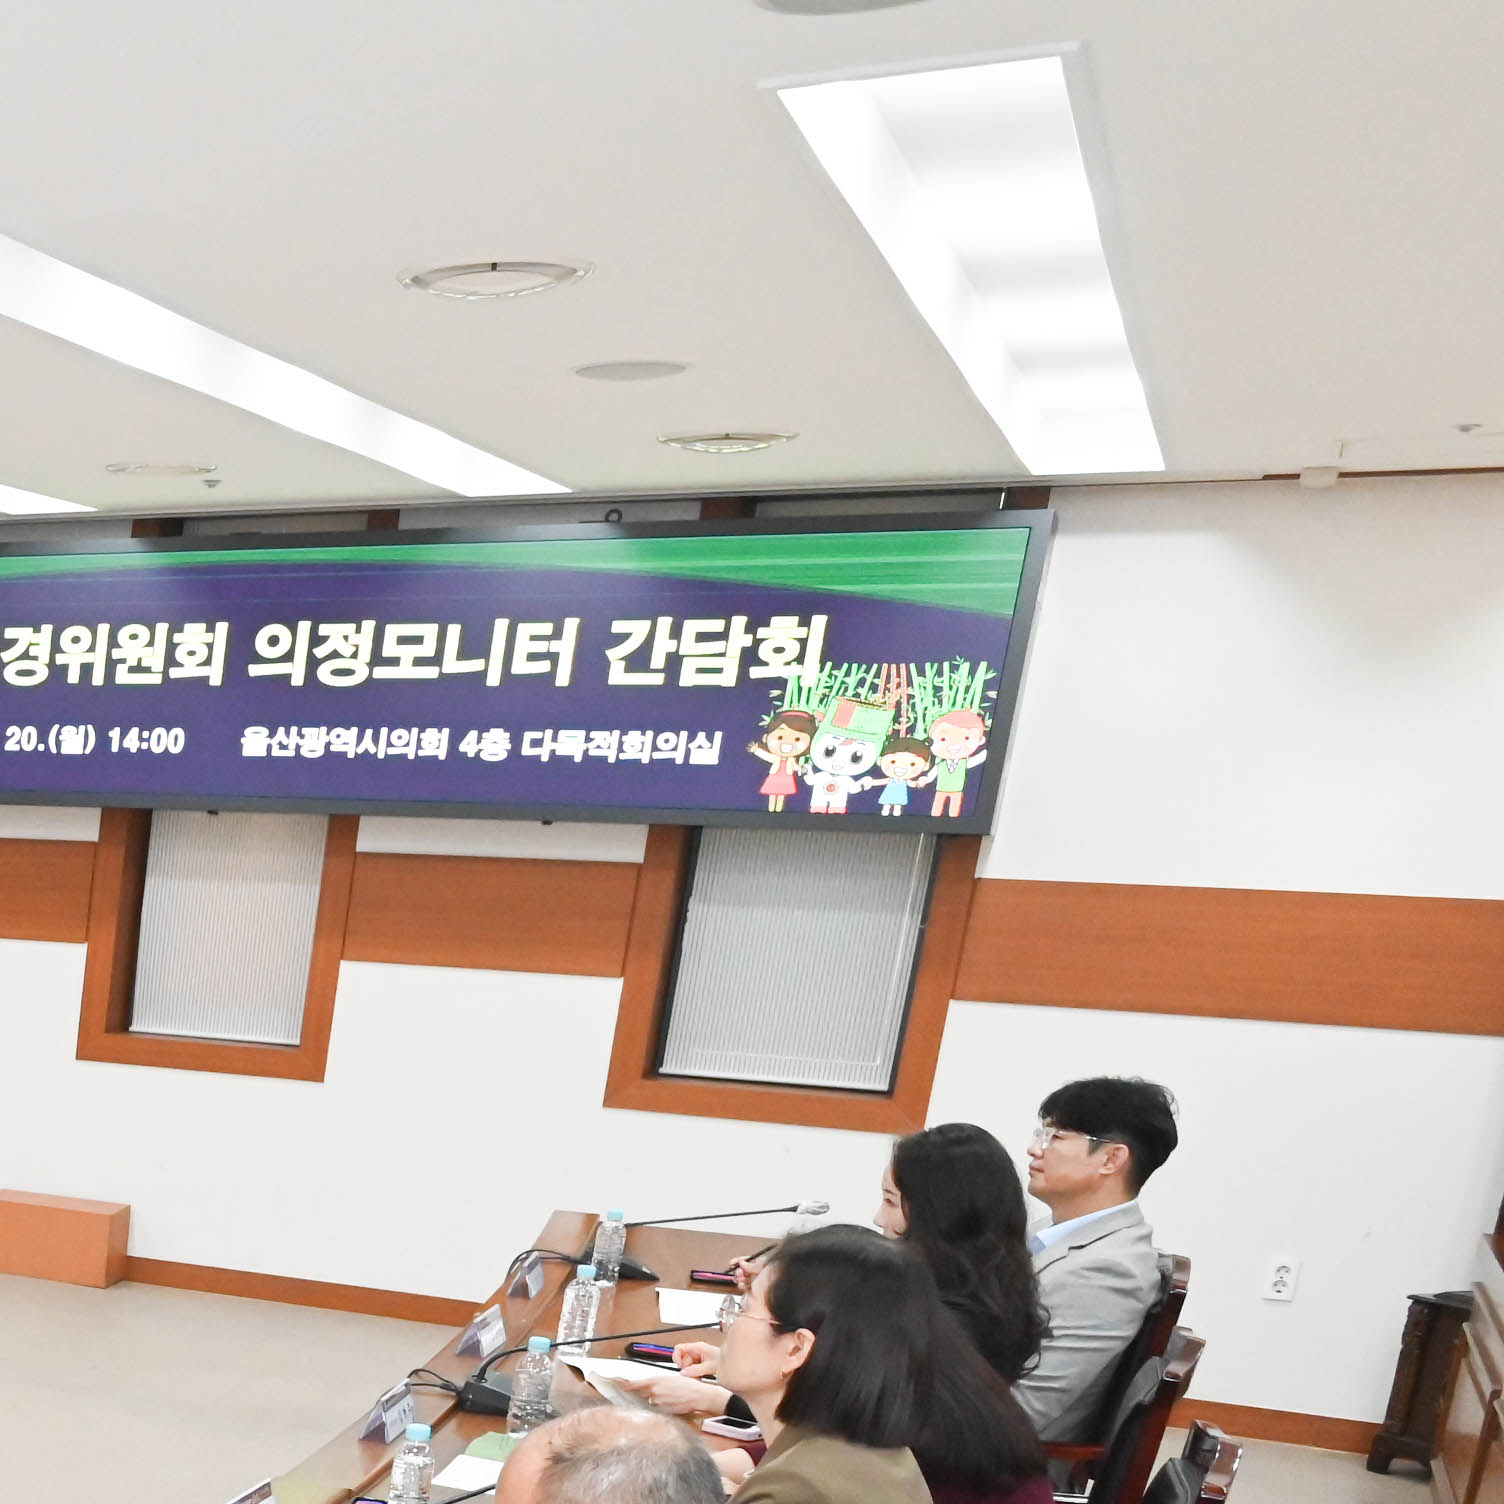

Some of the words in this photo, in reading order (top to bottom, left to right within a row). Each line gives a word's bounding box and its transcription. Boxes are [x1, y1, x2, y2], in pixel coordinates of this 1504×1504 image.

[248, 617, 580, 687] 의정모니터
[605, 614, 829, 687] 간담회
[108, 727, 186, 753] 14:00
[240, 726, 449, 760] 울산광역시의회
[458, 729, 511, 762] 4층
[521, 730, 723, 765] 다목적회의실
